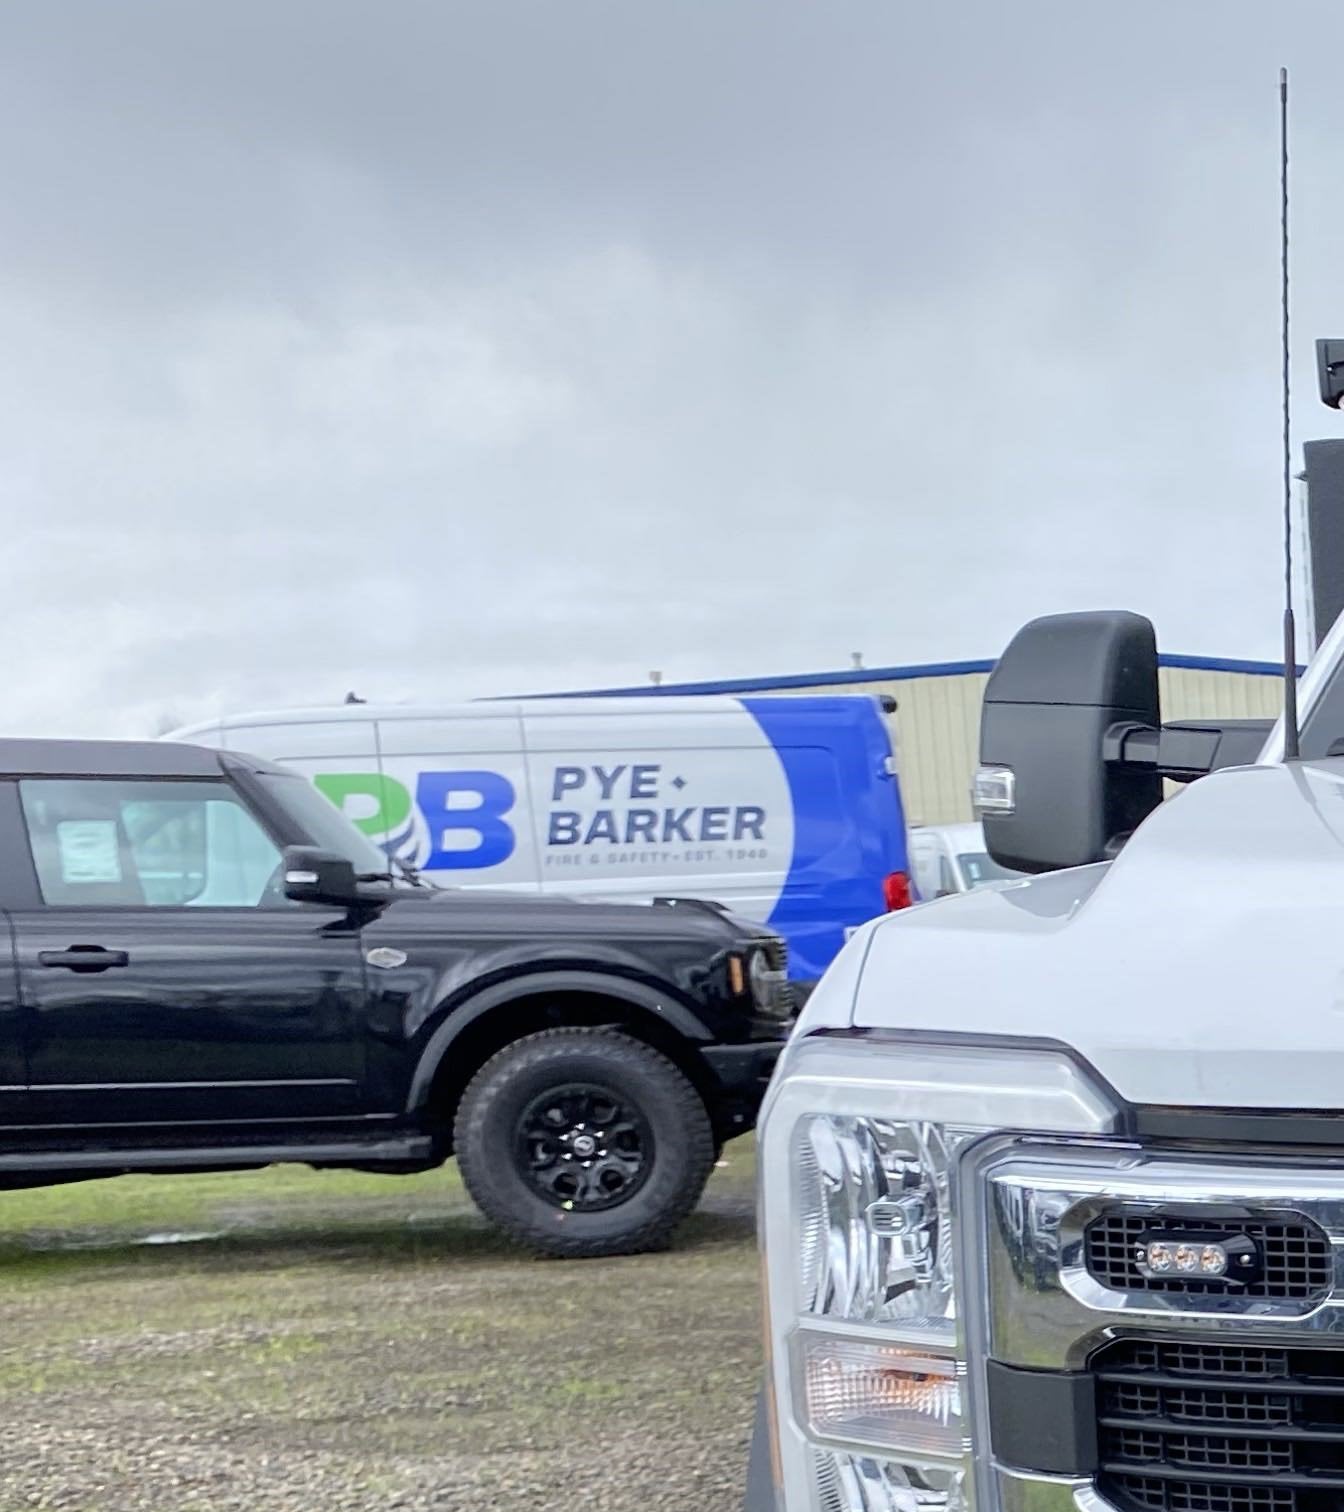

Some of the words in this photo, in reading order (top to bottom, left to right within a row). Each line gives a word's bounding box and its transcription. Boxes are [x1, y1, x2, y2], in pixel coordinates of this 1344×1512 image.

[551, 764, 661, 801] PYE
[548, 805, 768, 846] BARKER
[545, 854, 582, 866] FIRE
